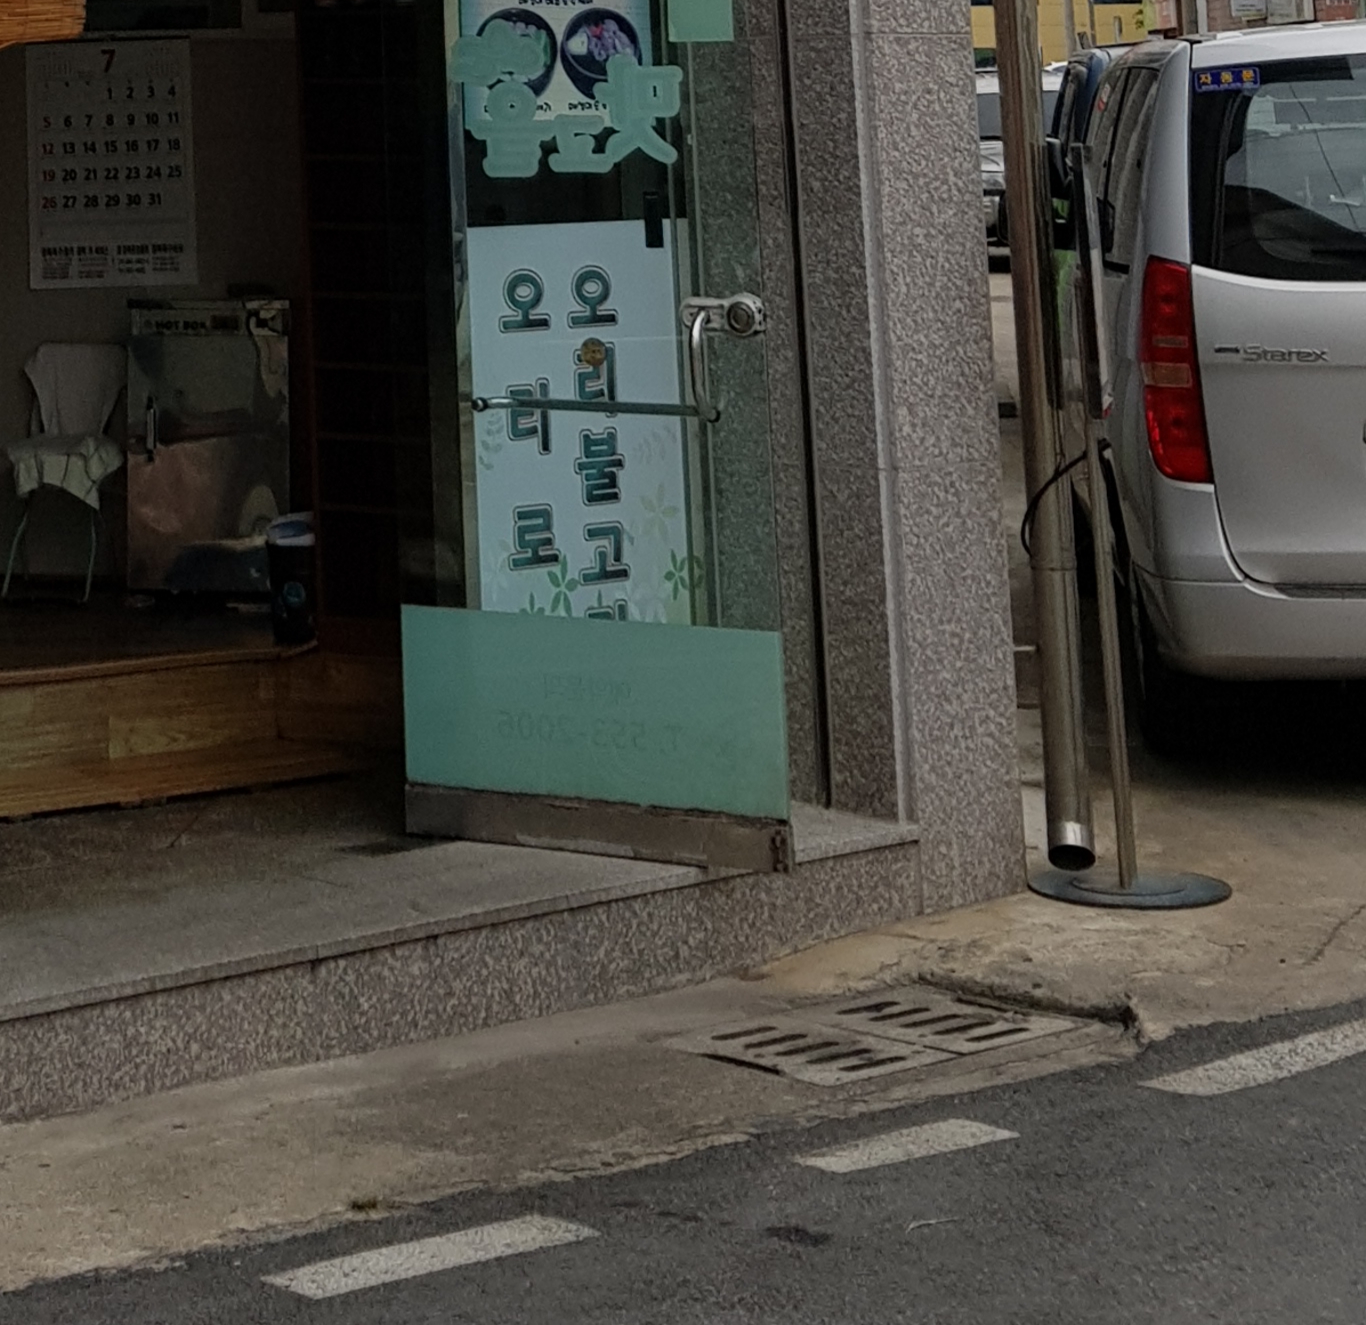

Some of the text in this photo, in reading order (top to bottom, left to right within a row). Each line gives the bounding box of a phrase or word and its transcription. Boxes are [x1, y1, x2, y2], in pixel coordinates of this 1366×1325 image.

[100, 48, 116, 74] 7
[1242, 342, 1330, 363] Starex
[566, 264, 632, 622] 오리불고
